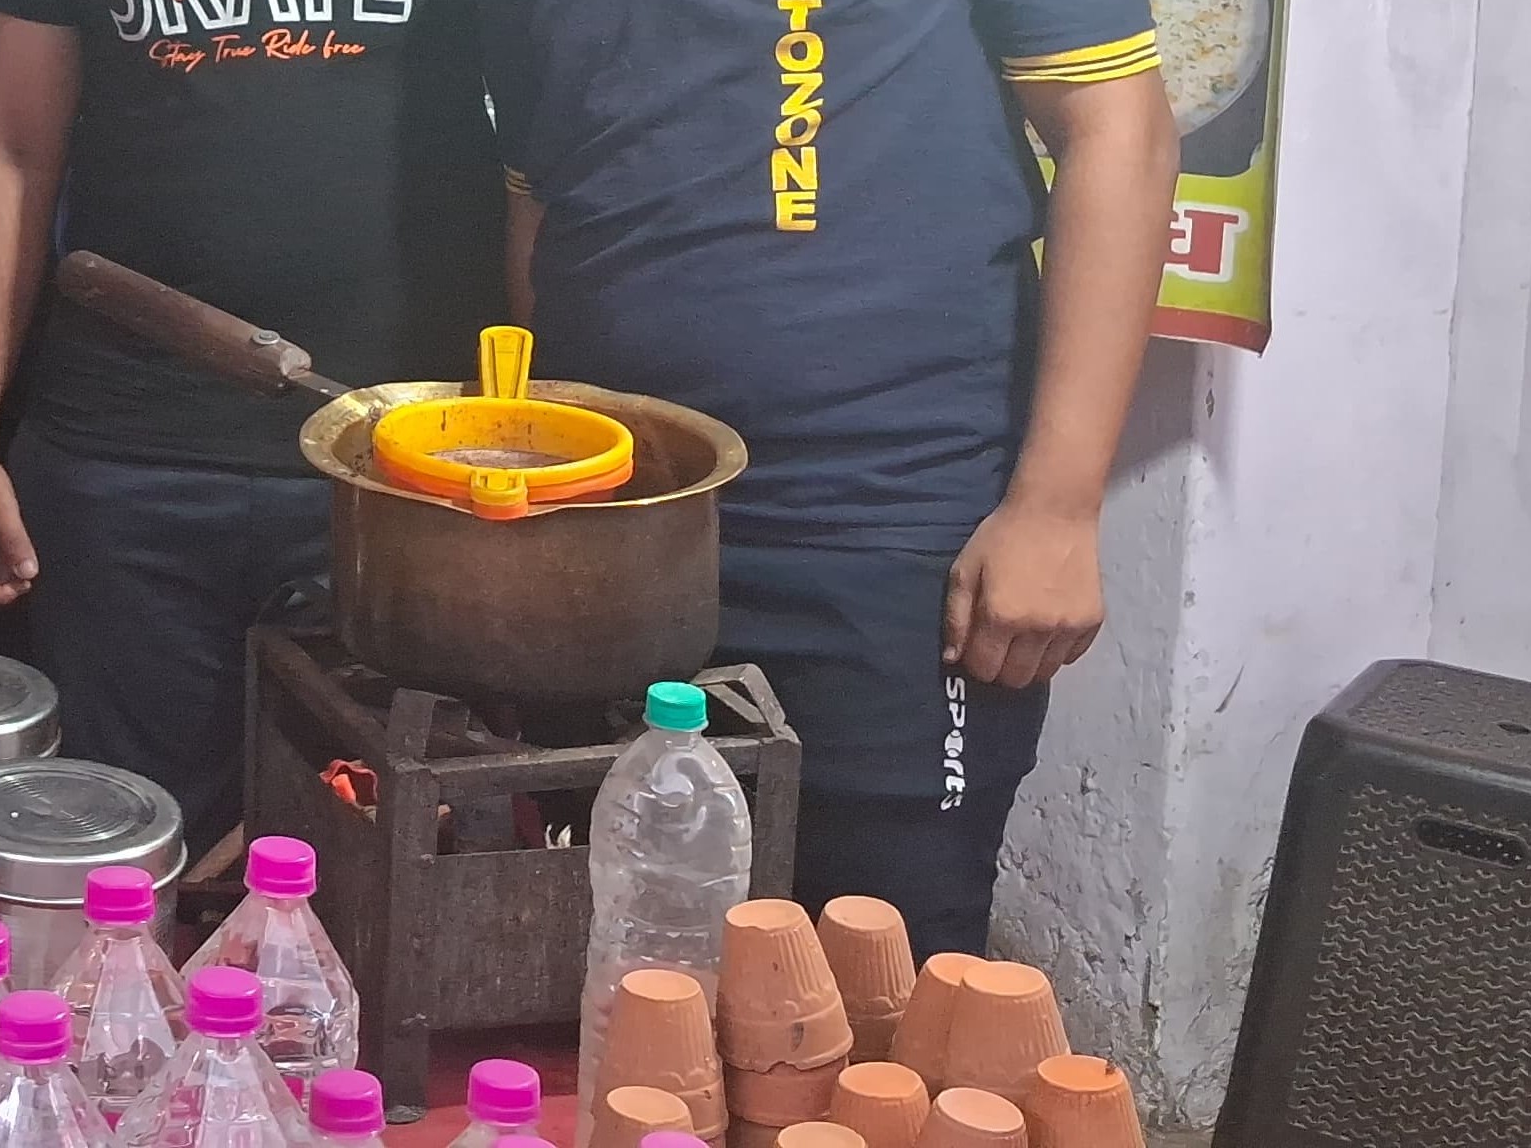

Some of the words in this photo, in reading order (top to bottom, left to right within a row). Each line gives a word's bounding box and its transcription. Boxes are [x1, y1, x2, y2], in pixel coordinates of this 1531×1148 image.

[148, 38, 207, 73] Stay
[211, 34, 257, 63] True
[261, 28, 316, 59] Ride
